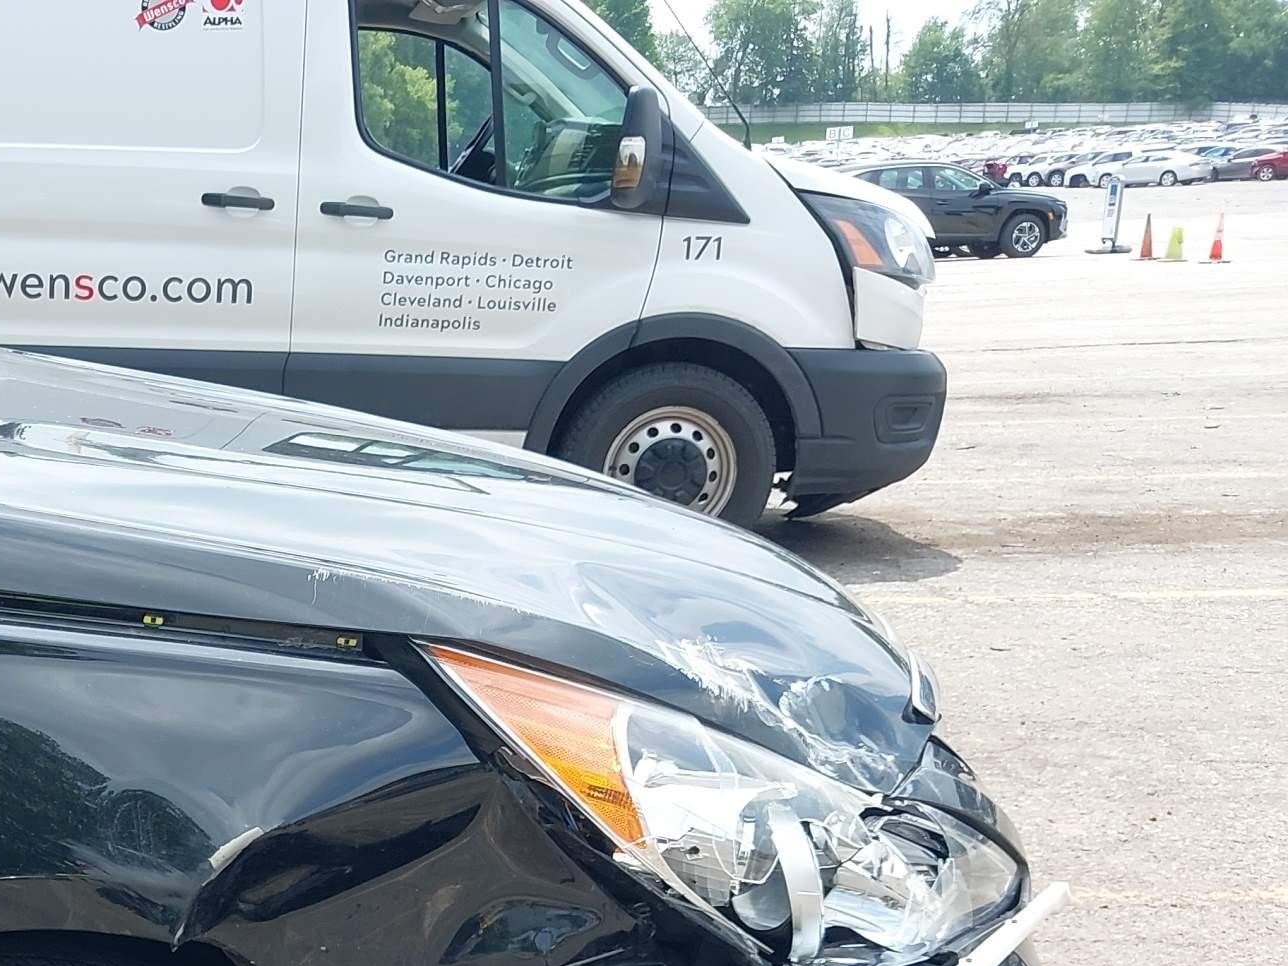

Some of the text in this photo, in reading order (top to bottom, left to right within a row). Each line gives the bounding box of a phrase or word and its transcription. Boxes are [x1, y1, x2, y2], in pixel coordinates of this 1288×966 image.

[203, 16, 242, 26] ALPHA
[682, 236, 723, 261] 171
[384, 249, 574, 270] Grand Rapids Detroit
[382, 271, 554, 294] Davenport Chicago
[380, 292, 557, 312] Cleveland Louisville
[378, 313, 481, 332] Indianapolis
